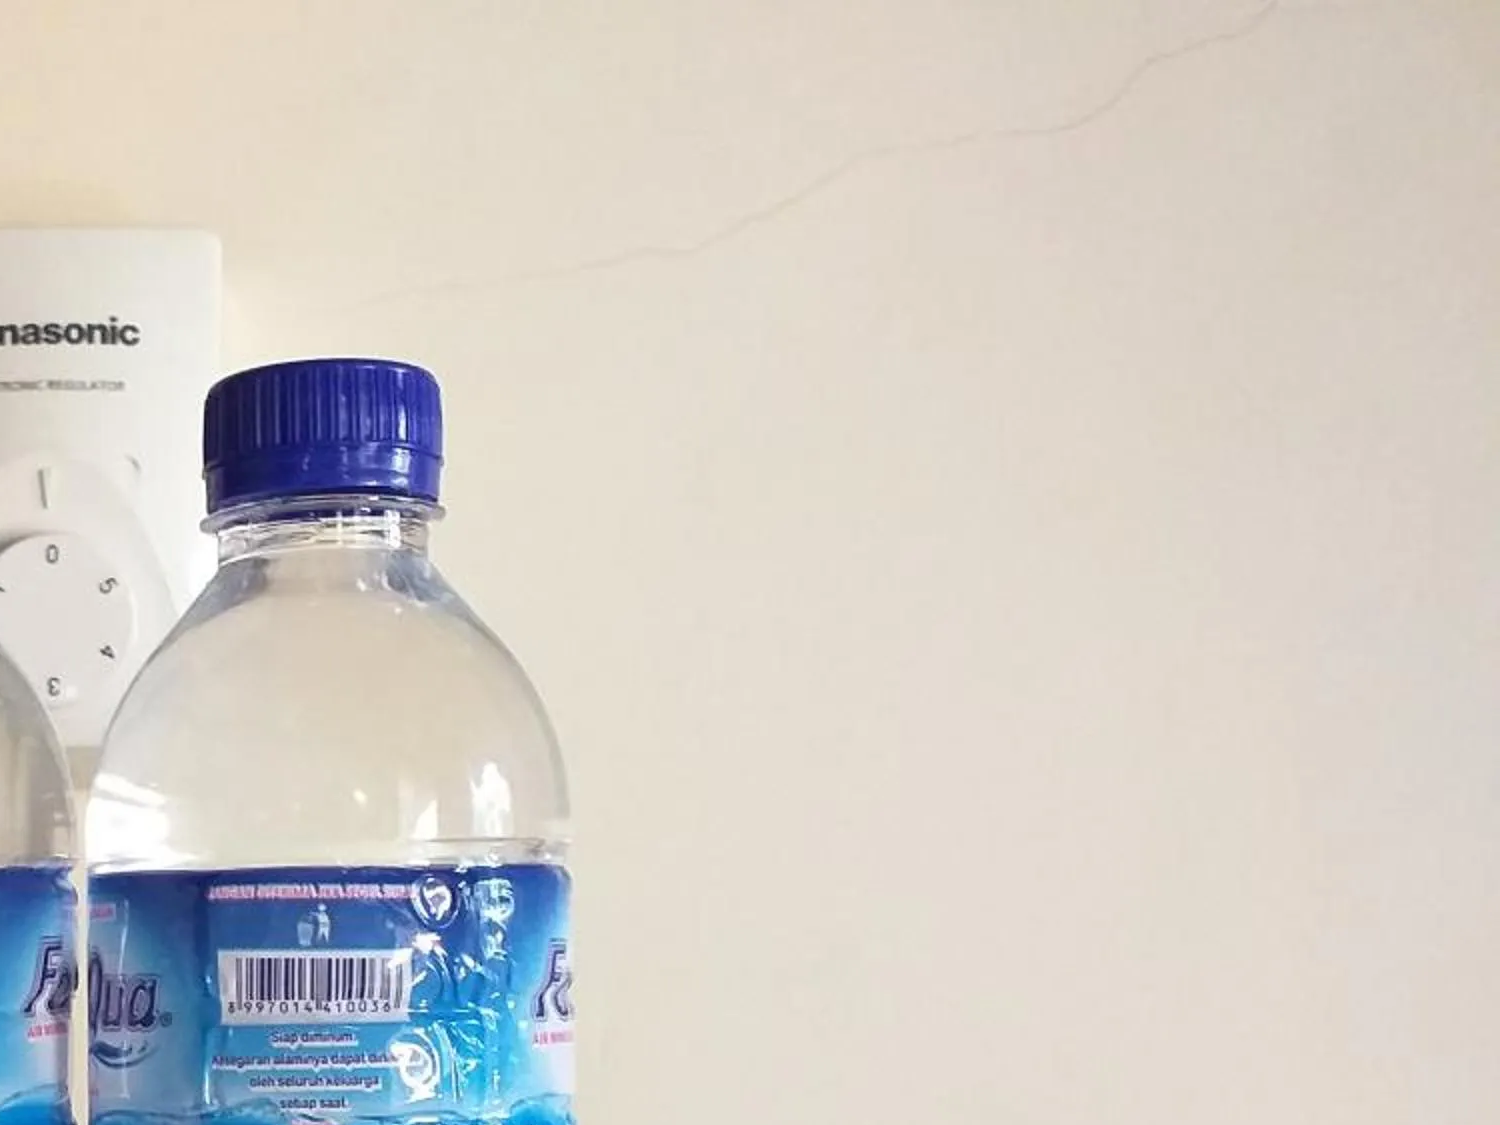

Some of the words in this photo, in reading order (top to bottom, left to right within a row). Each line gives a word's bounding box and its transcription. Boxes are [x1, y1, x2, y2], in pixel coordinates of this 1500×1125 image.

[100, 577, 119, 594] 5
[47, 677, 60, 697] 3
[271, 1031, 299, 1045] Siap
